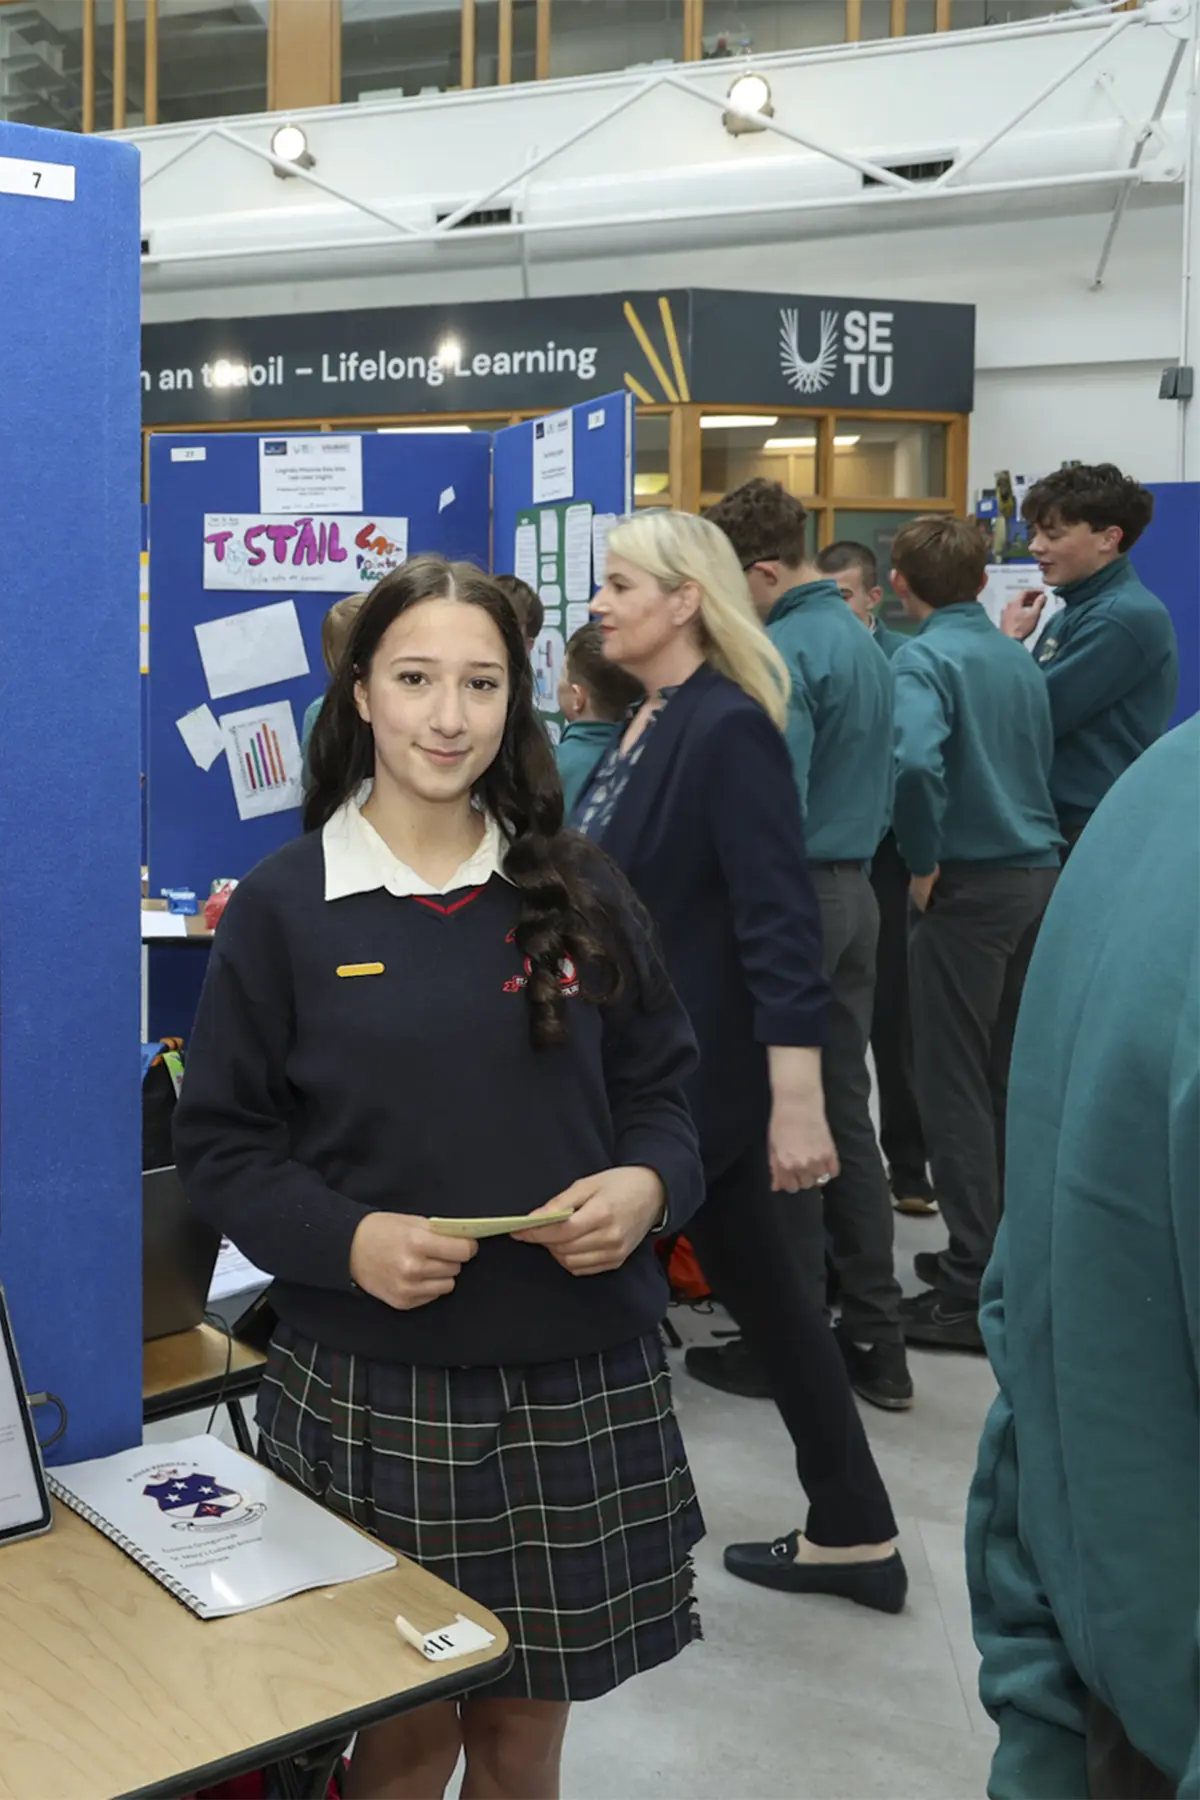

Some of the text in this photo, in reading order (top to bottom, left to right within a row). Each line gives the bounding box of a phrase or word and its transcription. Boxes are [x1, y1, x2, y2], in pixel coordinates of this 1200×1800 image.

[32, 172, 42, 189] 7
[844, 310, 894, 352] SE
[158, 367, 194, 390] an
[200, 356, 284, 388] taoil
[322, 350, 444, 386] Lifelong
[454, 341, 598, 380] Learning
[844, 354, 892, 396] TU
